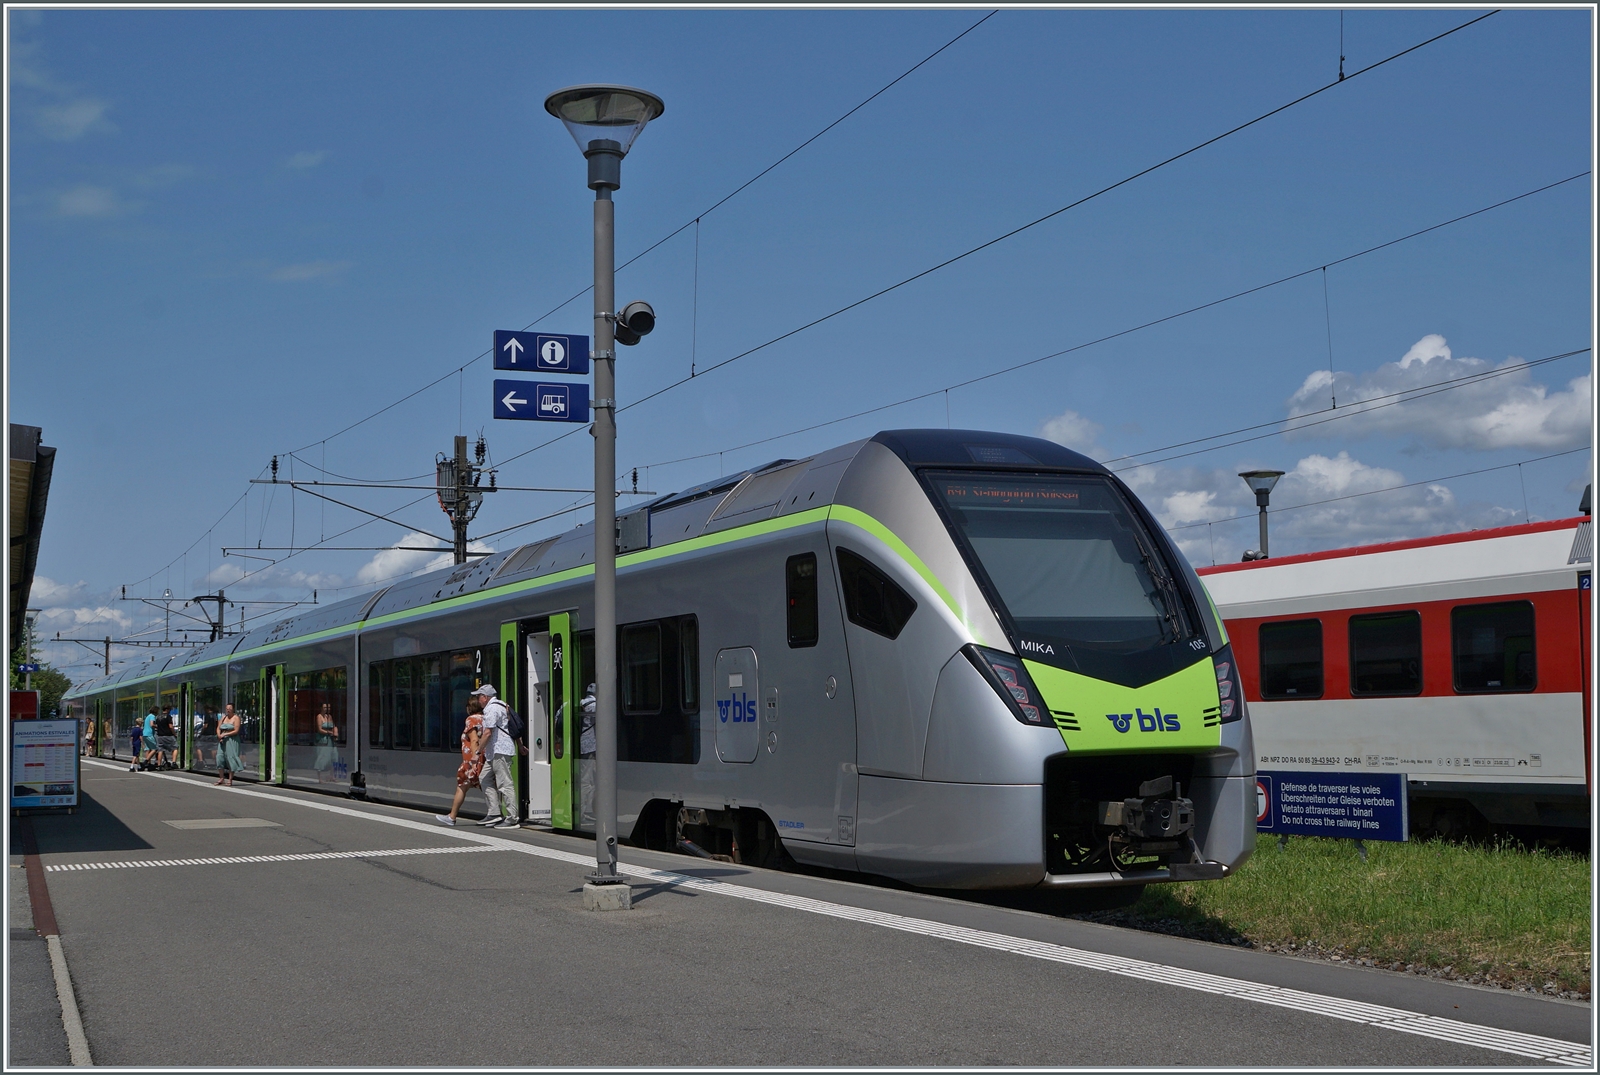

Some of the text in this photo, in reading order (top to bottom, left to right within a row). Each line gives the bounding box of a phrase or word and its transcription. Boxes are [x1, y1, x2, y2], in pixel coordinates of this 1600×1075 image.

[1582, 578, 1590, 589] 2
[1020, 640, 1055, 655] MIKA
[1188, 639, 1206, 651] 105
[476, 649, 482, 673] 2
[732, 692, 756, 722] bls
[1135, 708, 1181, 732] bls
[1344, 757, 1362, 765] CH-RA
[1280, 782, 1381, 795] Défense de traverser les voies
[1280, 792, 1395, 807] Überschreiten der Gleise verboten
[1281, 804, 1304, 814] Vietato
[1305, 805, 1346, 816] attraversare
[1352, 807, 1373, 817] binari
[778, 820, 805, 829] STADLER
[1282, 814, 1380, 830] Do not cross the railway lines
